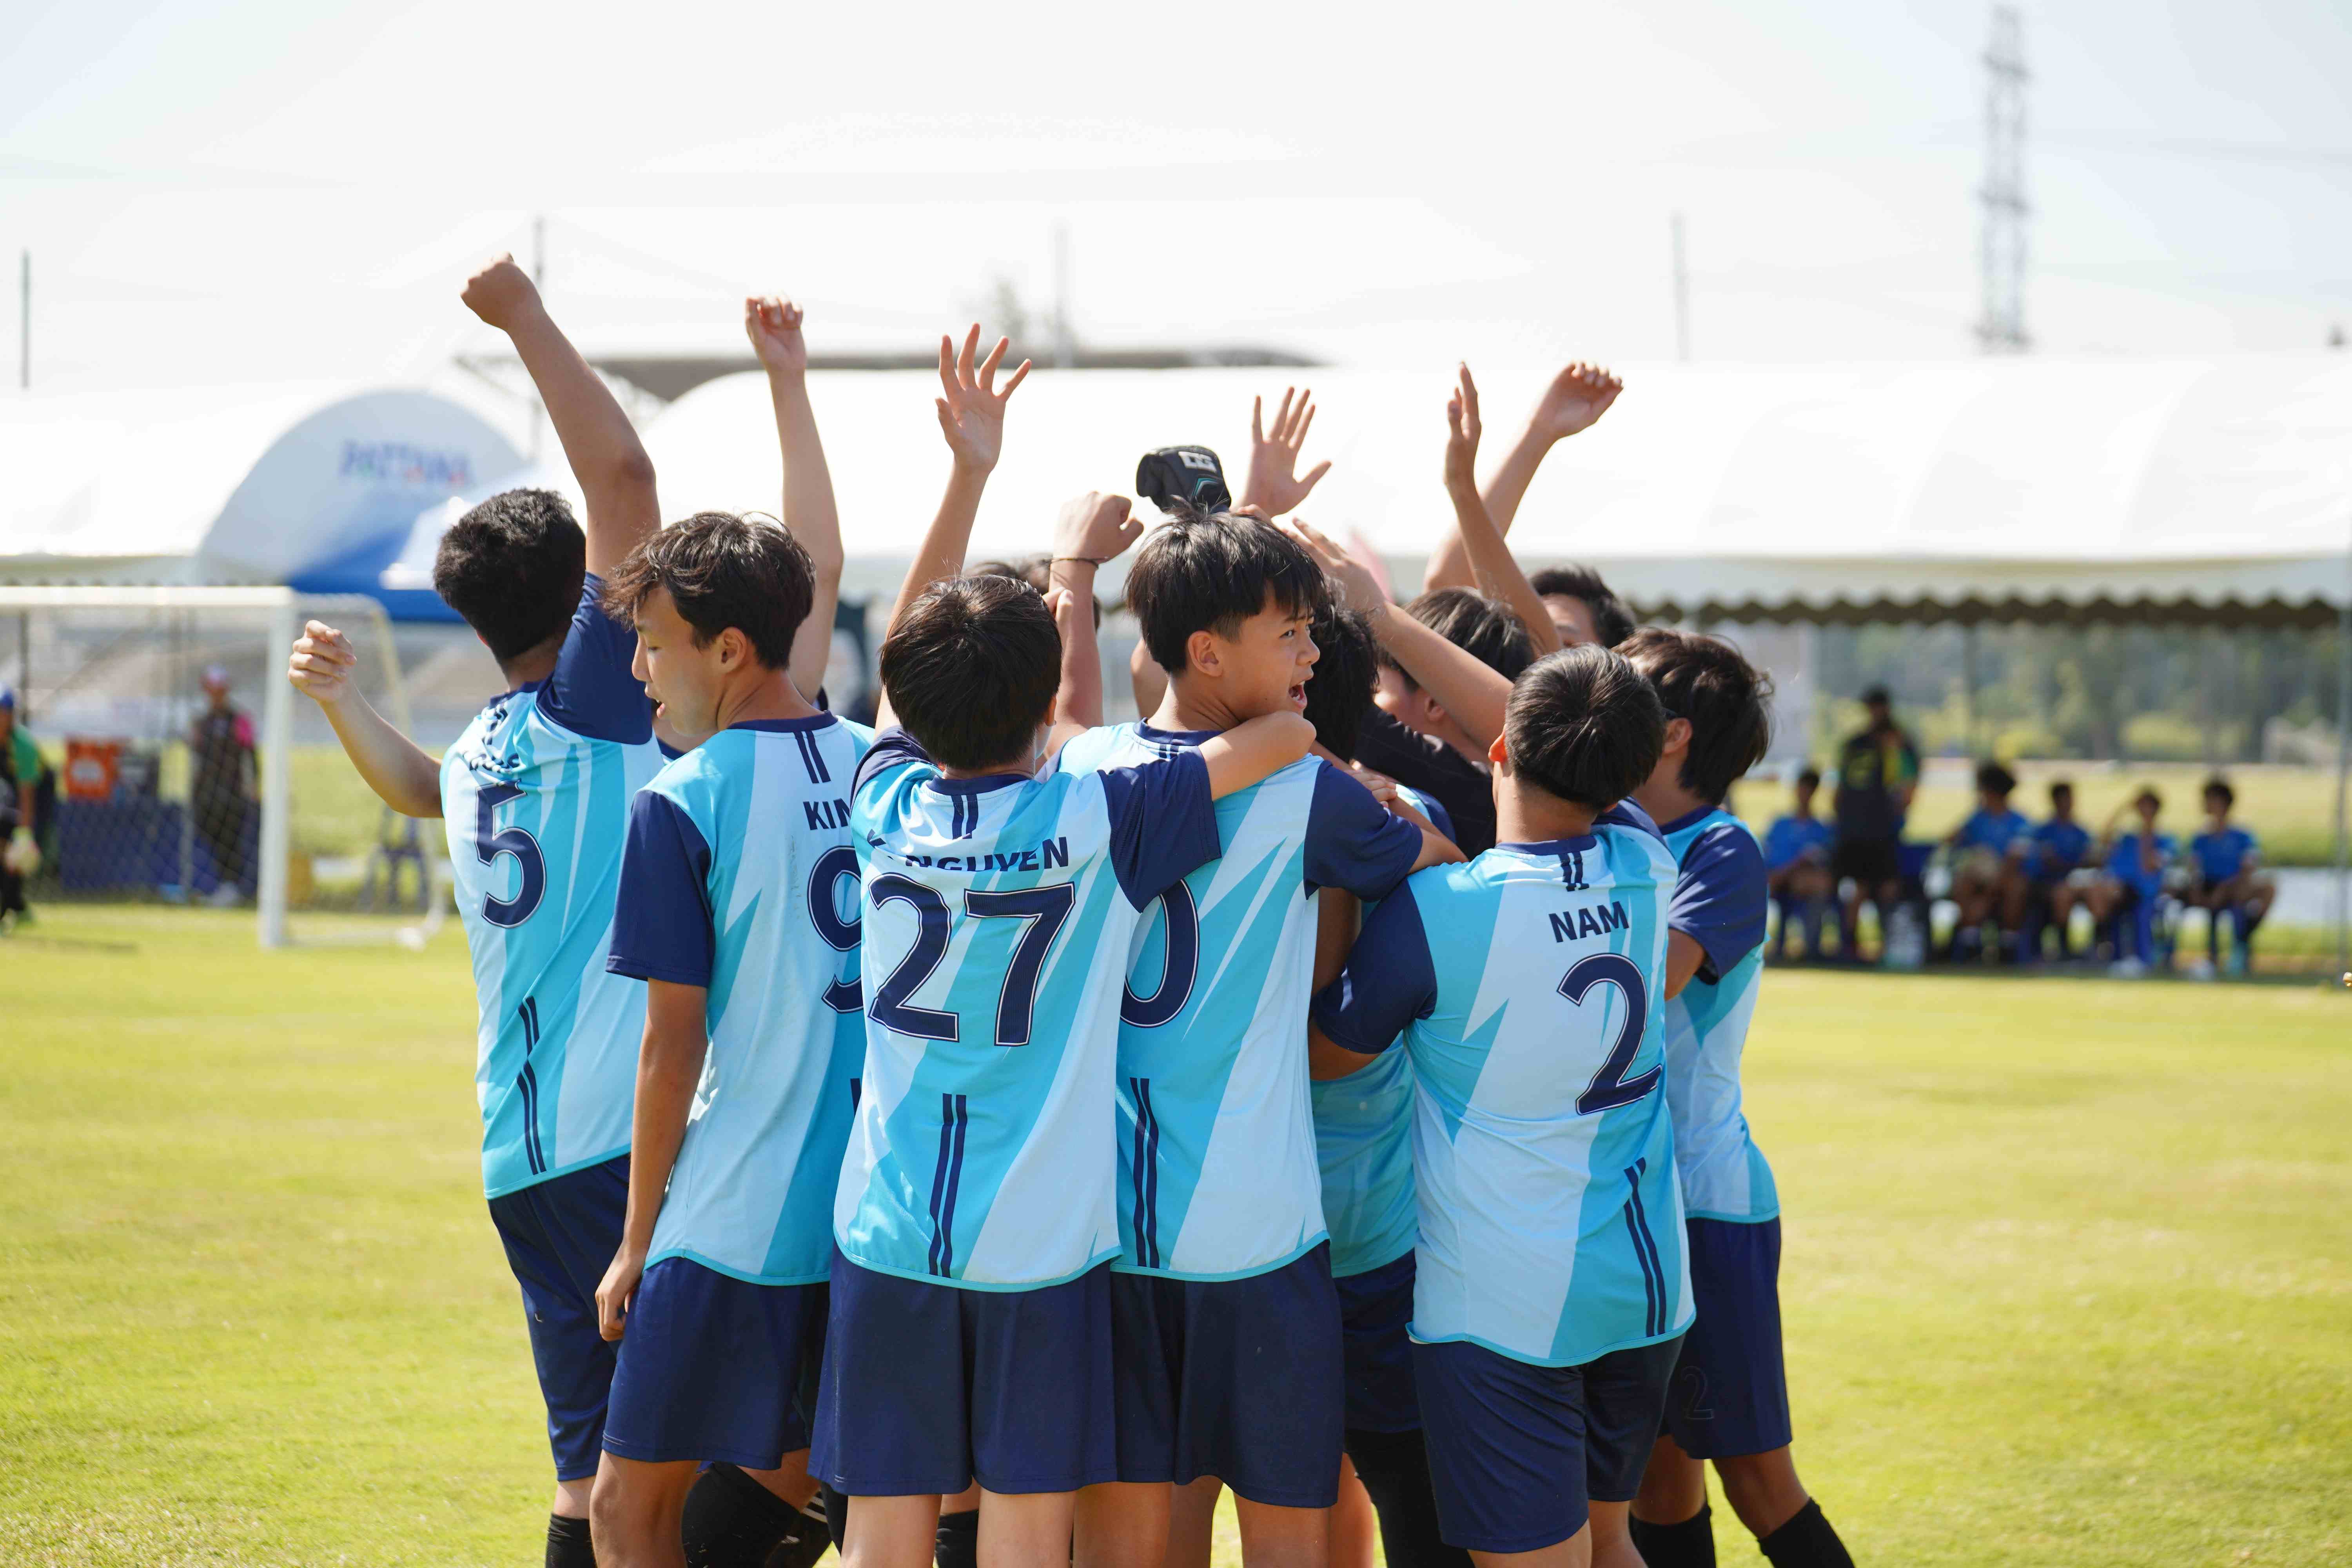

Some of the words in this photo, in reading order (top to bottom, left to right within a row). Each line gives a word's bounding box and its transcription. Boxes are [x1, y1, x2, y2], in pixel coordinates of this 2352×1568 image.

[475, 779, 547, 929] 5
[906, 837, 1069, 872] NGUYEN
[1548, 901, 1630, 943] NAM
[807, 845, 864, 1014] 9
[867, 872, 1076, 1047] 27
[1556, 952, 1663, 1116] 2
[1679, 1365, 1714, 1420] 2
